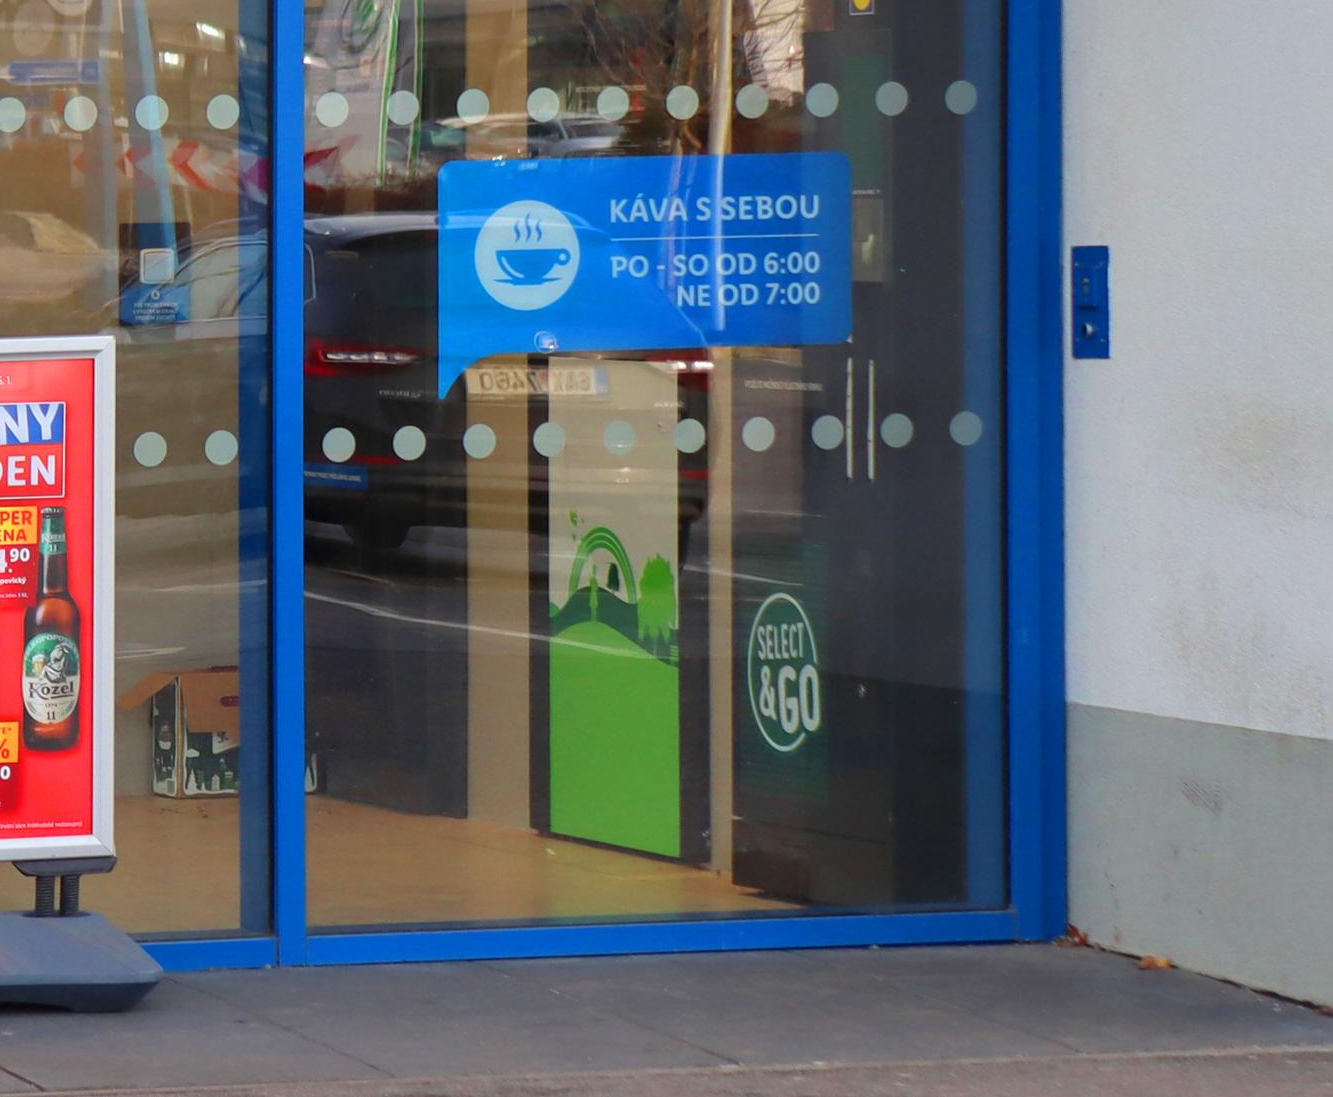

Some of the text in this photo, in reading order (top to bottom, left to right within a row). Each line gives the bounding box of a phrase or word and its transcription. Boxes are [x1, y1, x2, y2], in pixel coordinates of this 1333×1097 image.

[610, 193, 820, 223] KÁVA S SEBOU
[611, 255, 649, 278] PO
[673, 254, 712, 277] SO
[718, 253, 756, 276] OD
[764, 252, 821, 274] 6:00
[677, 282, 821, 307] NE OD 7:00
[757, 622, 804, 660] SELECT
[29, 682, 74, 700] Kozel
[759, 664, 821, 735] &GO
[46, 712, 56, 720] 11
